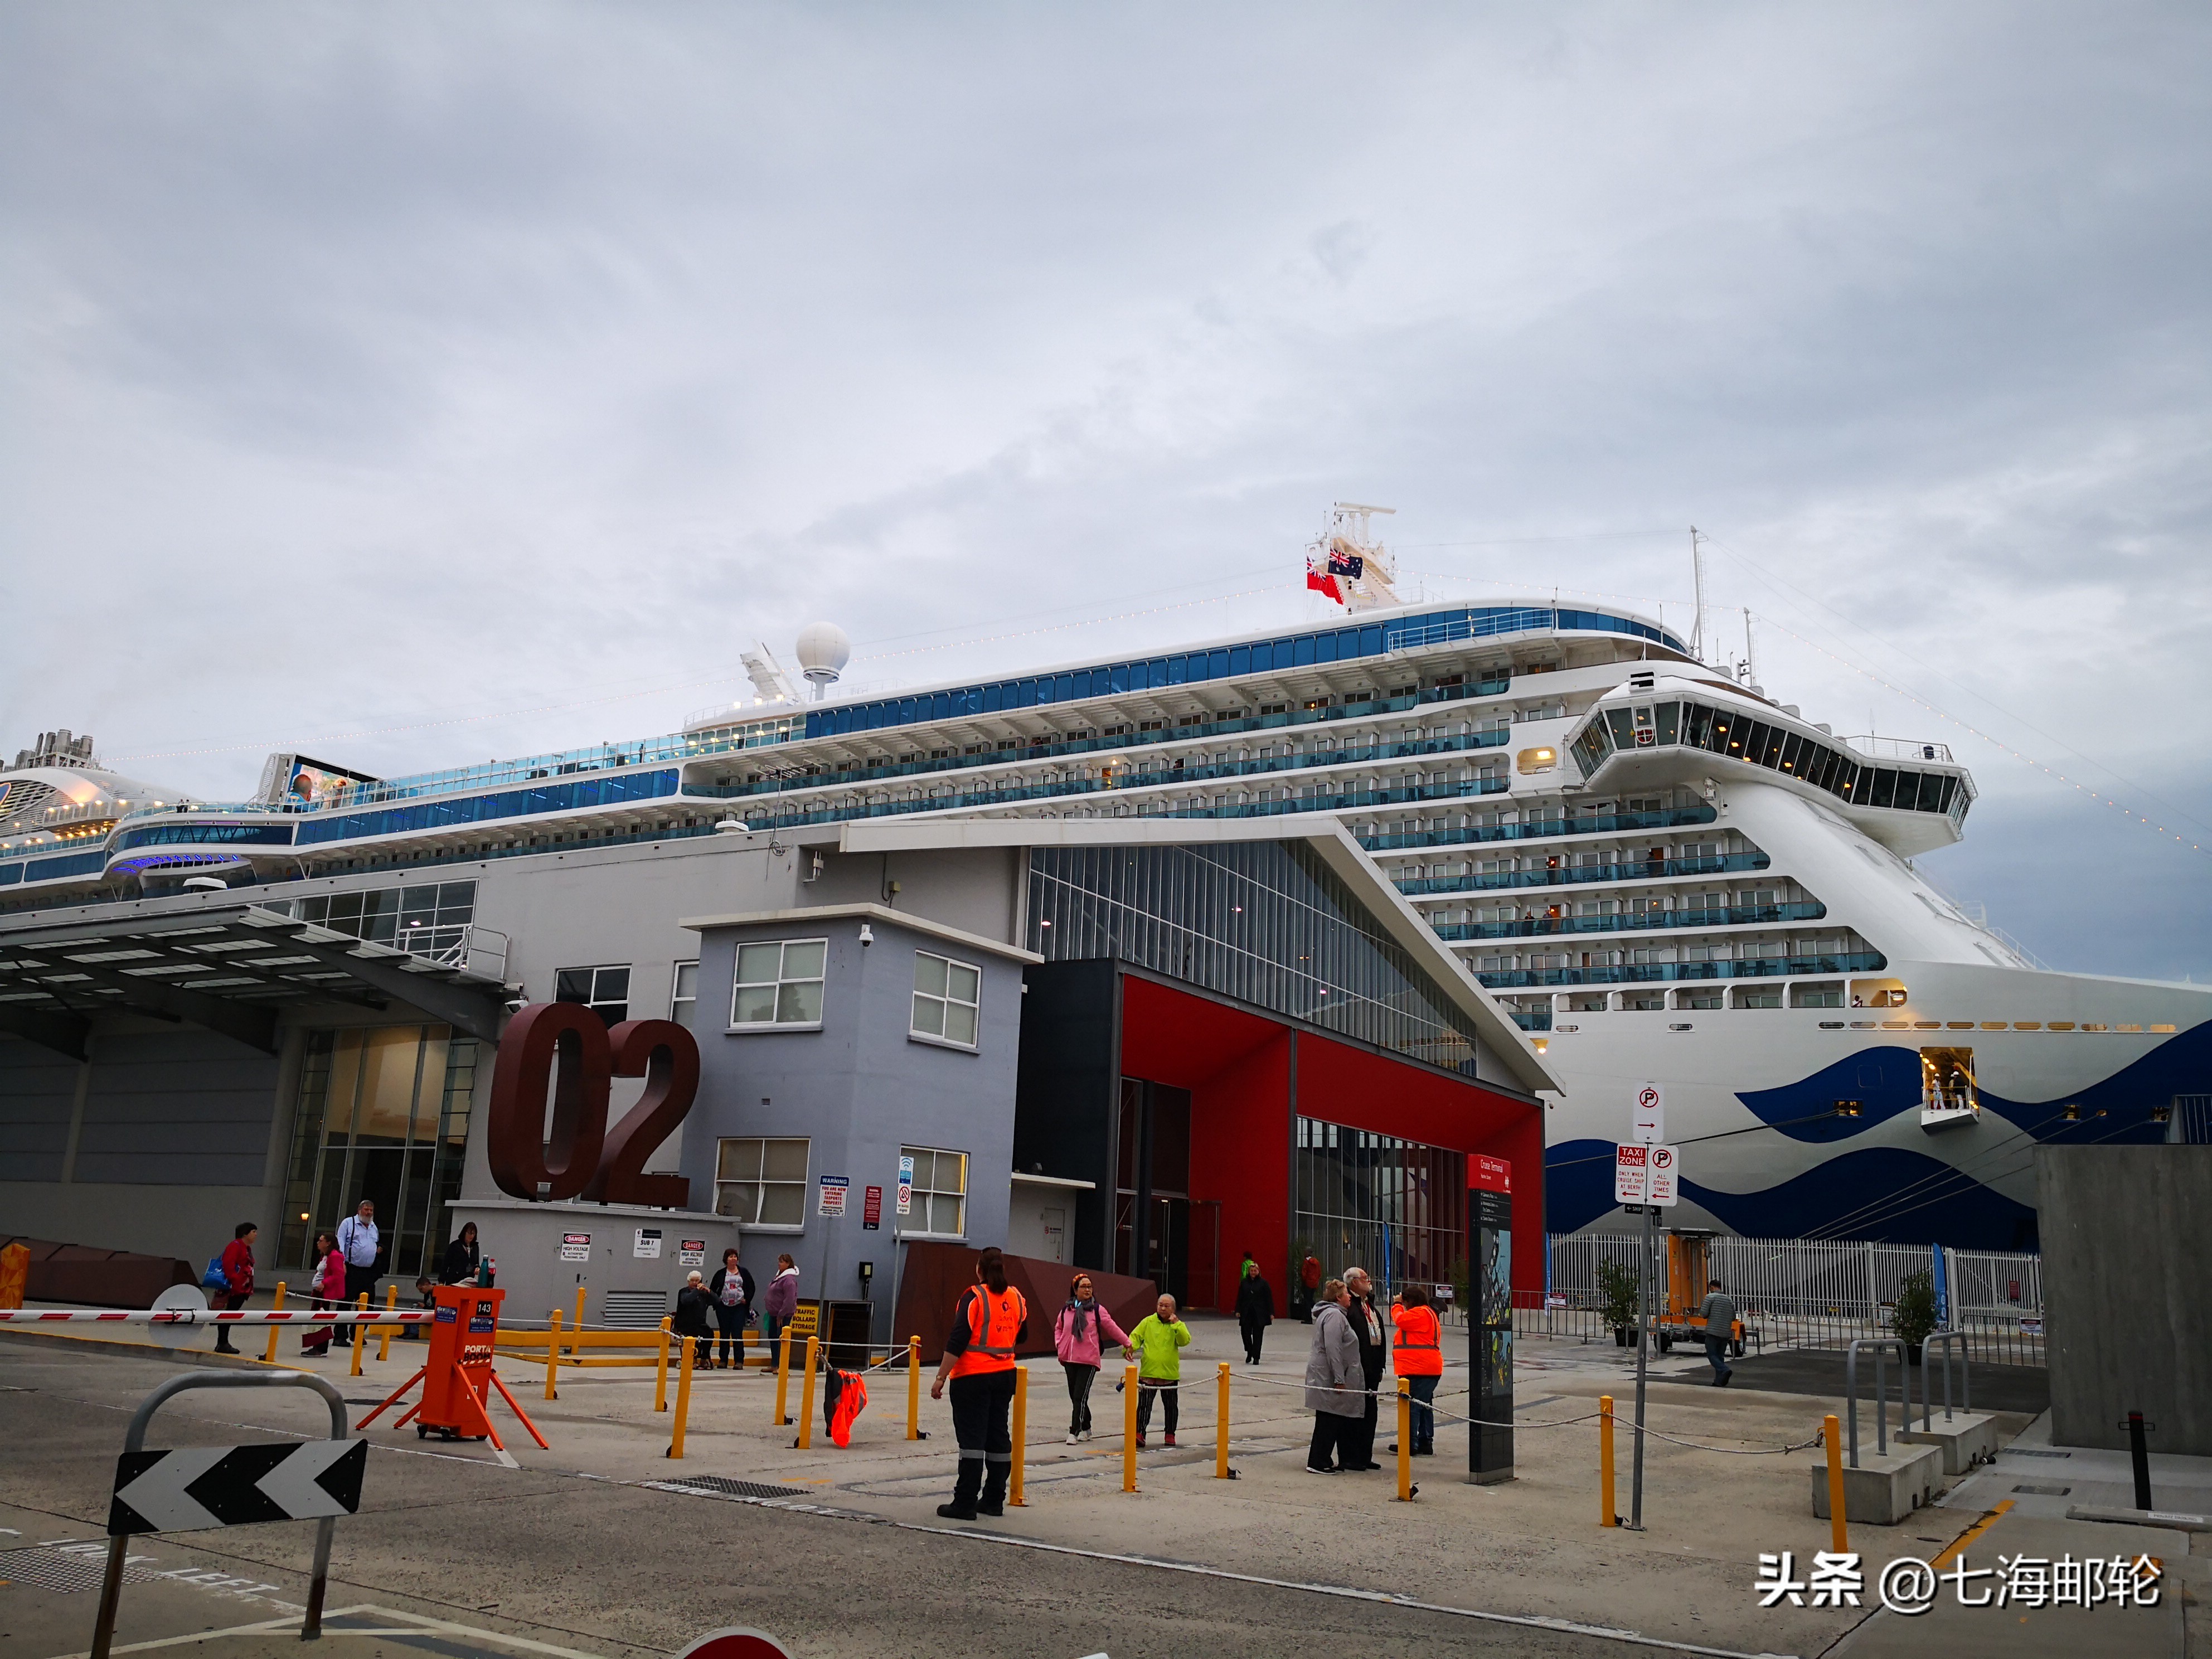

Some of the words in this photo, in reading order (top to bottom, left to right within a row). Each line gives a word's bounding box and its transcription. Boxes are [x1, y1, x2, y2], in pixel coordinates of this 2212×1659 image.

[1645, 1093, 1655, 1104] P
[488, 1002, 700, 1207] 02
[1622, 1148, 1643, 1156] TAXI
[1619, 1156, 1645, 1166] ZONE
[1658, 1152, 1668, 1165] P
[478, 1303, 491, 1313] 143
[464, 1345, 491, 1353] PORTA
[464, 1352, 491, 1361] BOOM
[159, 1568, 280, 1594] LEFT
